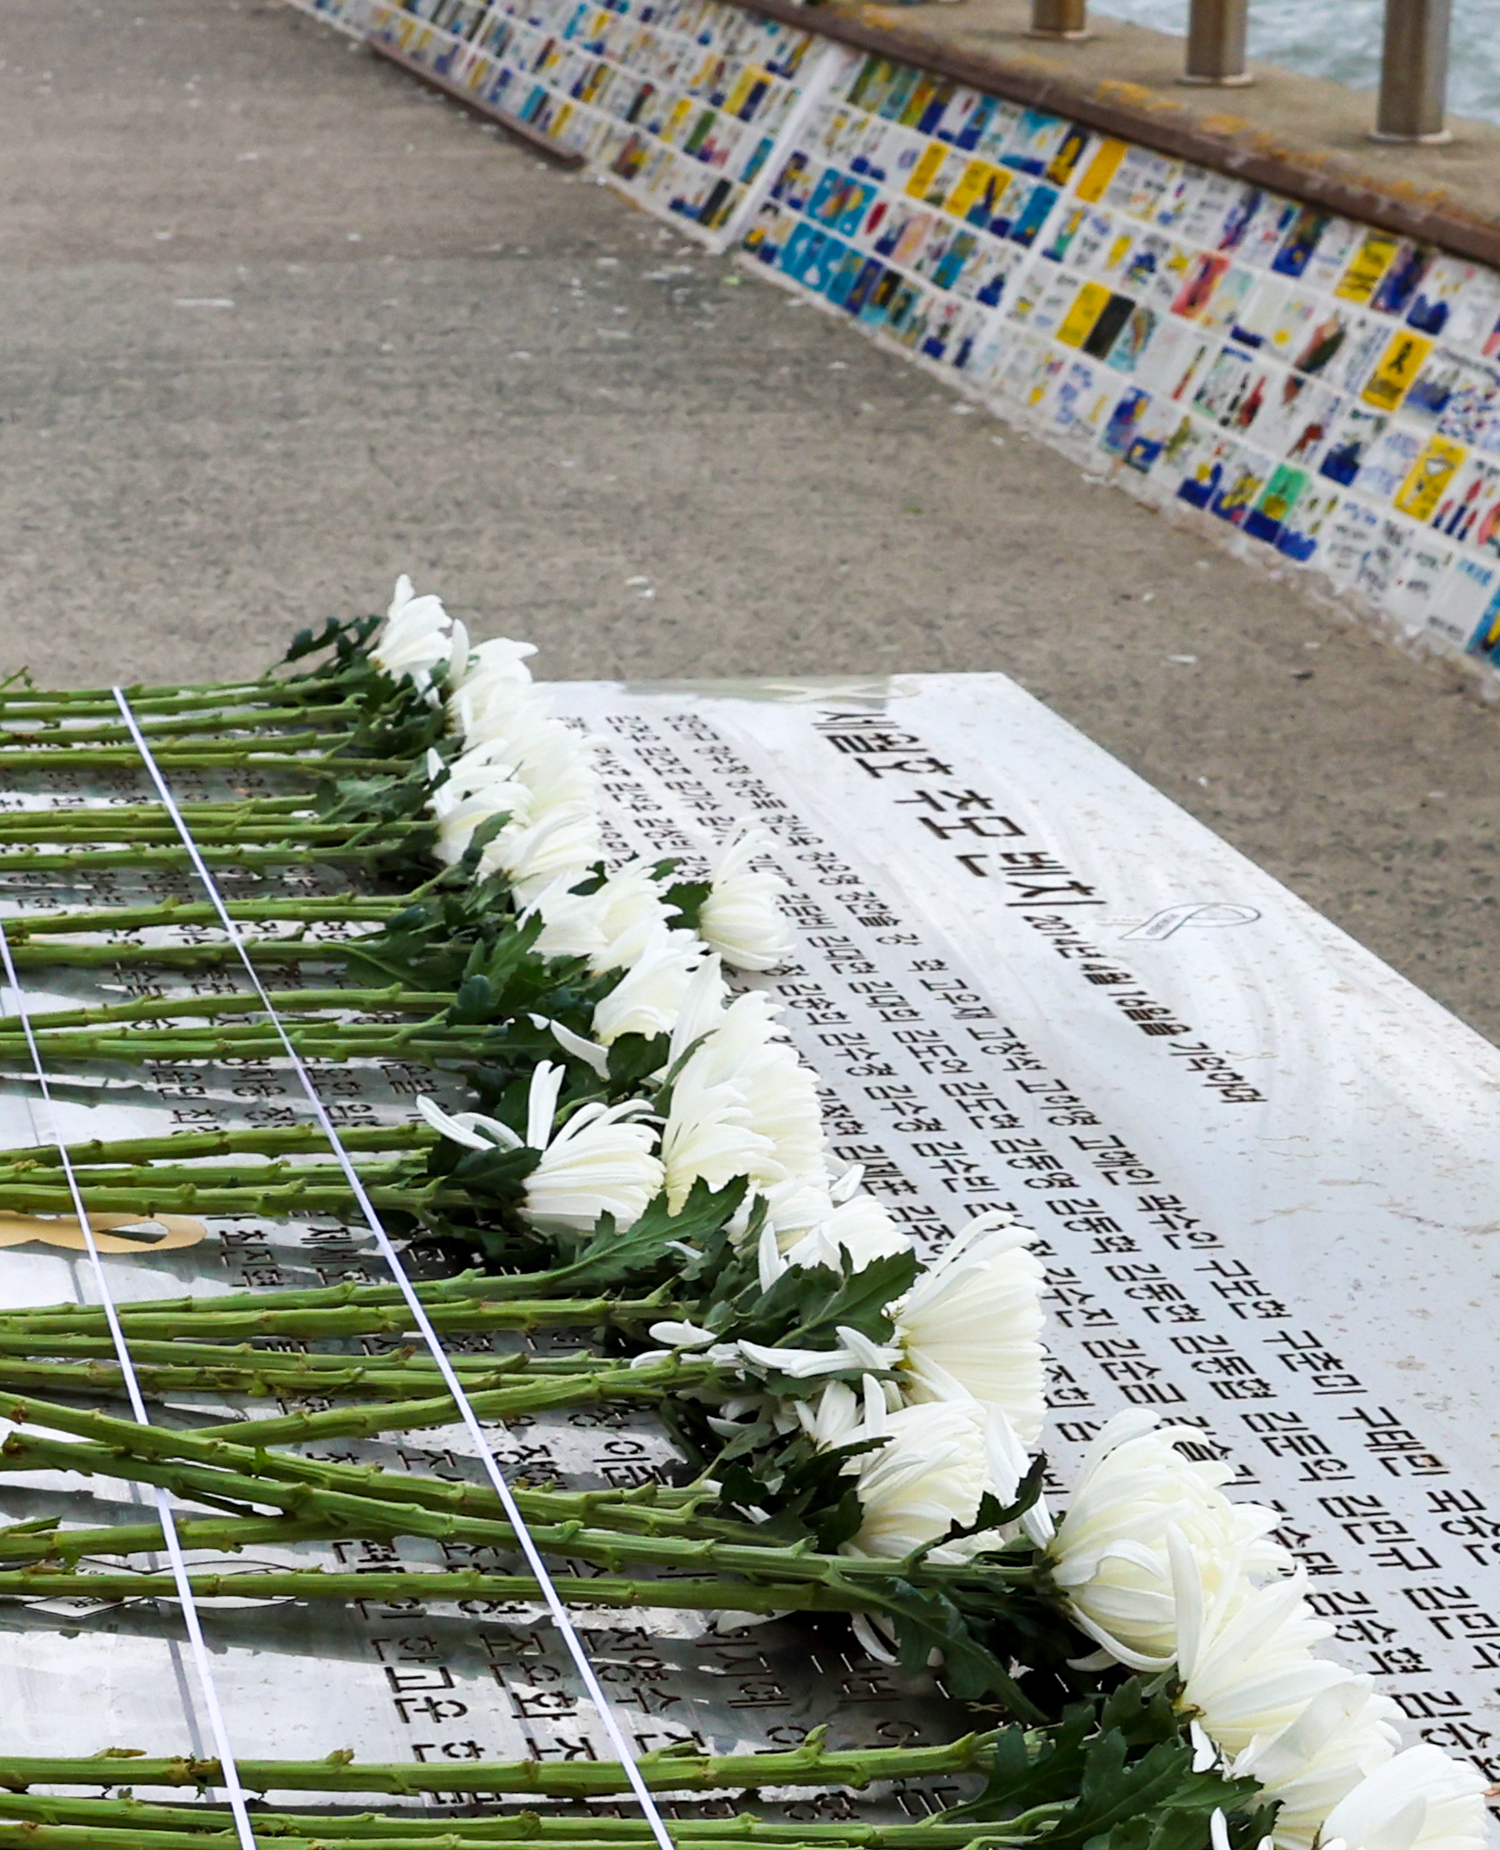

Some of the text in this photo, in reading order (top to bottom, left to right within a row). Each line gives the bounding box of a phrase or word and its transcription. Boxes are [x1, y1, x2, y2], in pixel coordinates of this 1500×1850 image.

[795, 851, 862, 885] 강우영
[812, 710, 1268, 1103] 세월호 추모 벤치 2014년 4월 16일을 기억하며
[834, 890, 901, 927] 강한솔
[868, 932, 929, 947] 강
[897, 958, 957, 972] 혁
[918, 977, 996, 1020] 고우재
[965, 1026, 1047, 1071] 고창석
[1014, 1078, 1102, 1126] 고하영
[1068, 1133, 1161, 1186] 고해인
[602, 782, 662, 813] 김선우
[633, 817, 690, 850] 김성빈
[775, 982, 851, 1025] 김송희
[817, 1031, 898, 1077] 김수경
[862, 1083, 947, 1132] 김수경
[910, 1140, 1000, 1193] 김수빈
[1080, 1338, 1188, 1404] 김순금
[1301, 1590, 1432, 1676] 김승혁
[1136, 1193, 1225, 1250] 곽수인
[805, 935, 878, 975] 김대현
[847, 980, 924, 1022] 김대희
[891, 1028, 973, 1075] 김도언
[938, 1081, 1025, 1130] 김도현
[989, 1137, 1081, 1189] 김동영
[1044, 1197, 1142, 1254] 김동혁
[1103, 1262, 1206, 1324] 김동현
[1168, 1333, 1278, 1400] 김동협
[1238, 1410, 1356, 1482] 김문익
[1316, 1494, 1442, 1572] 김민규
[1192, 1258, 1293, 1320] 구보현
[1261, 1329, 1368, 1395] 구춘미
[1336, 1405, 1450, 1477] 구태민
[217, 1229, 285, 1287] 최진혁
[370, 1633, 468, 1724] 한고운
[300, 1223, 372, 1286] 제세호
[476, 1627, 578, 1721] 조은화
[571, 1625, 682, 1714] 전영수
